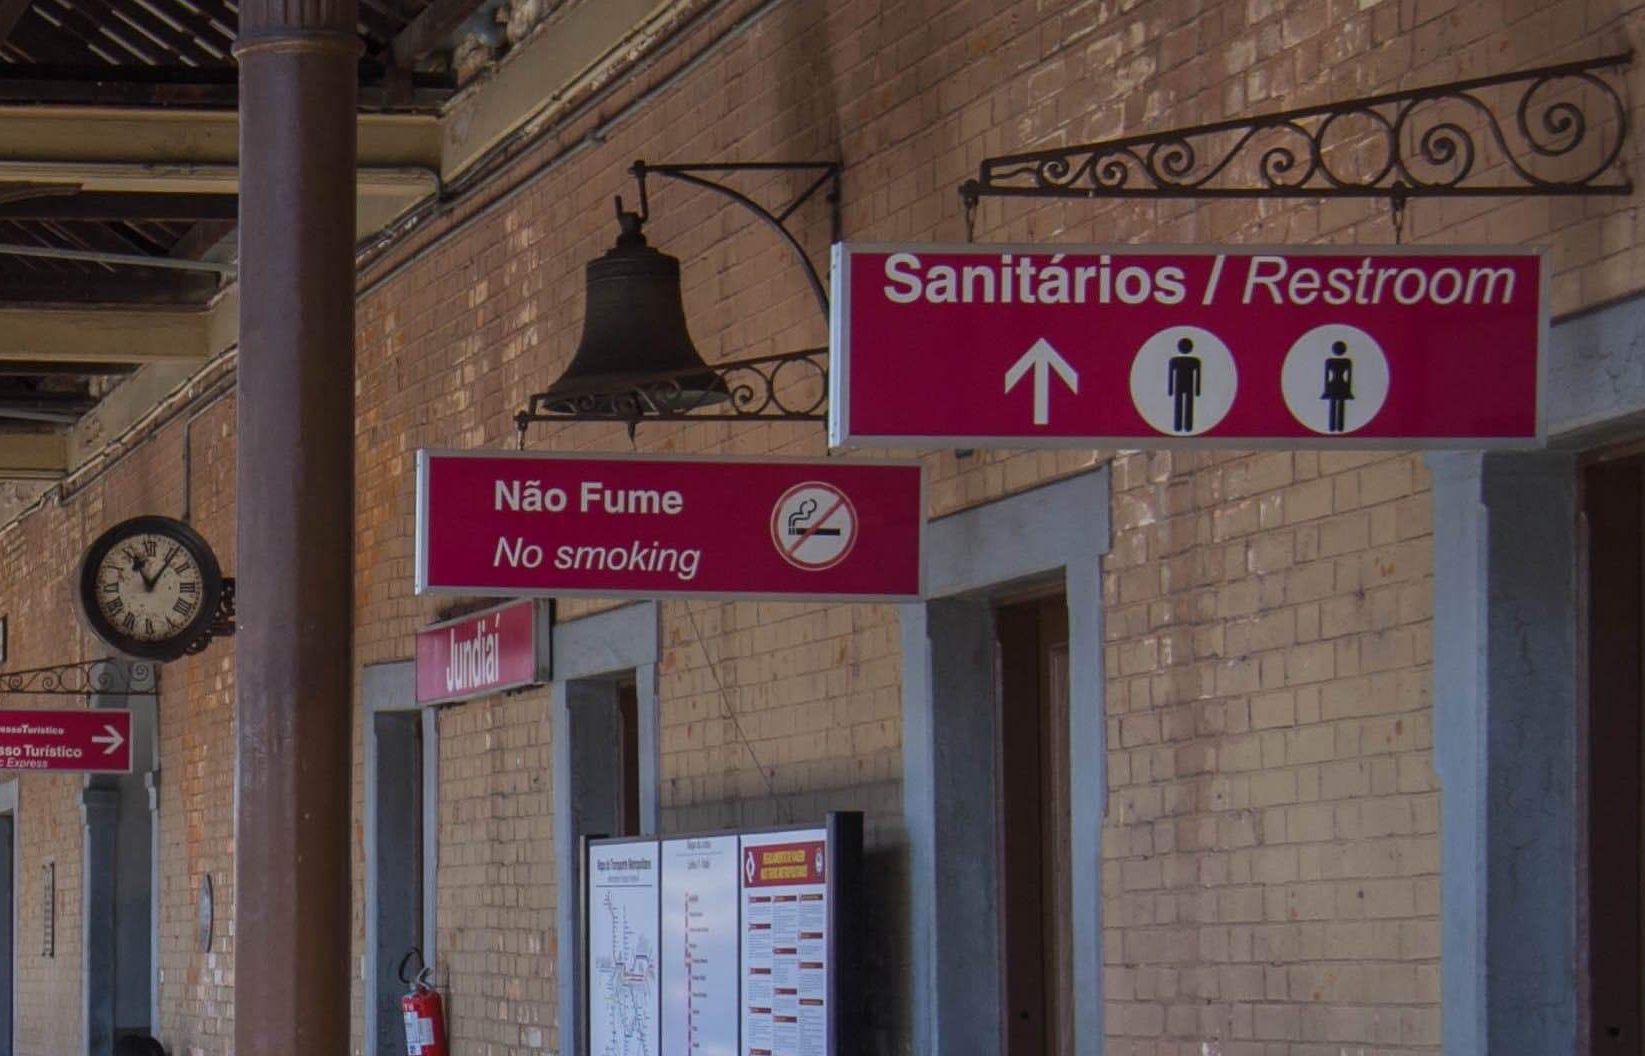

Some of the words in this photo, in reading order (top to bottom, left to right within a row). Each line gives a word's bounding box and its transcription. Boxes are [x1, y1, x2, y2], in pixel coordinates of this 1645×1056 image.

[882, 252, 1187, 306] Sanitários
[1201, 253, 1227, 306] /
[1242, 254, 1517, 306] Restroom
[493, 479, 568, 513] Não
[579, 481, 684, 515] Fume
[492, 536, 544, 569] No
[553, 540, 702, 581] smoking
[445, 612, 501, 693] Jundiaí
[6, 757, 49, 769] Express
[23, 744, 83, 759] Turístico
